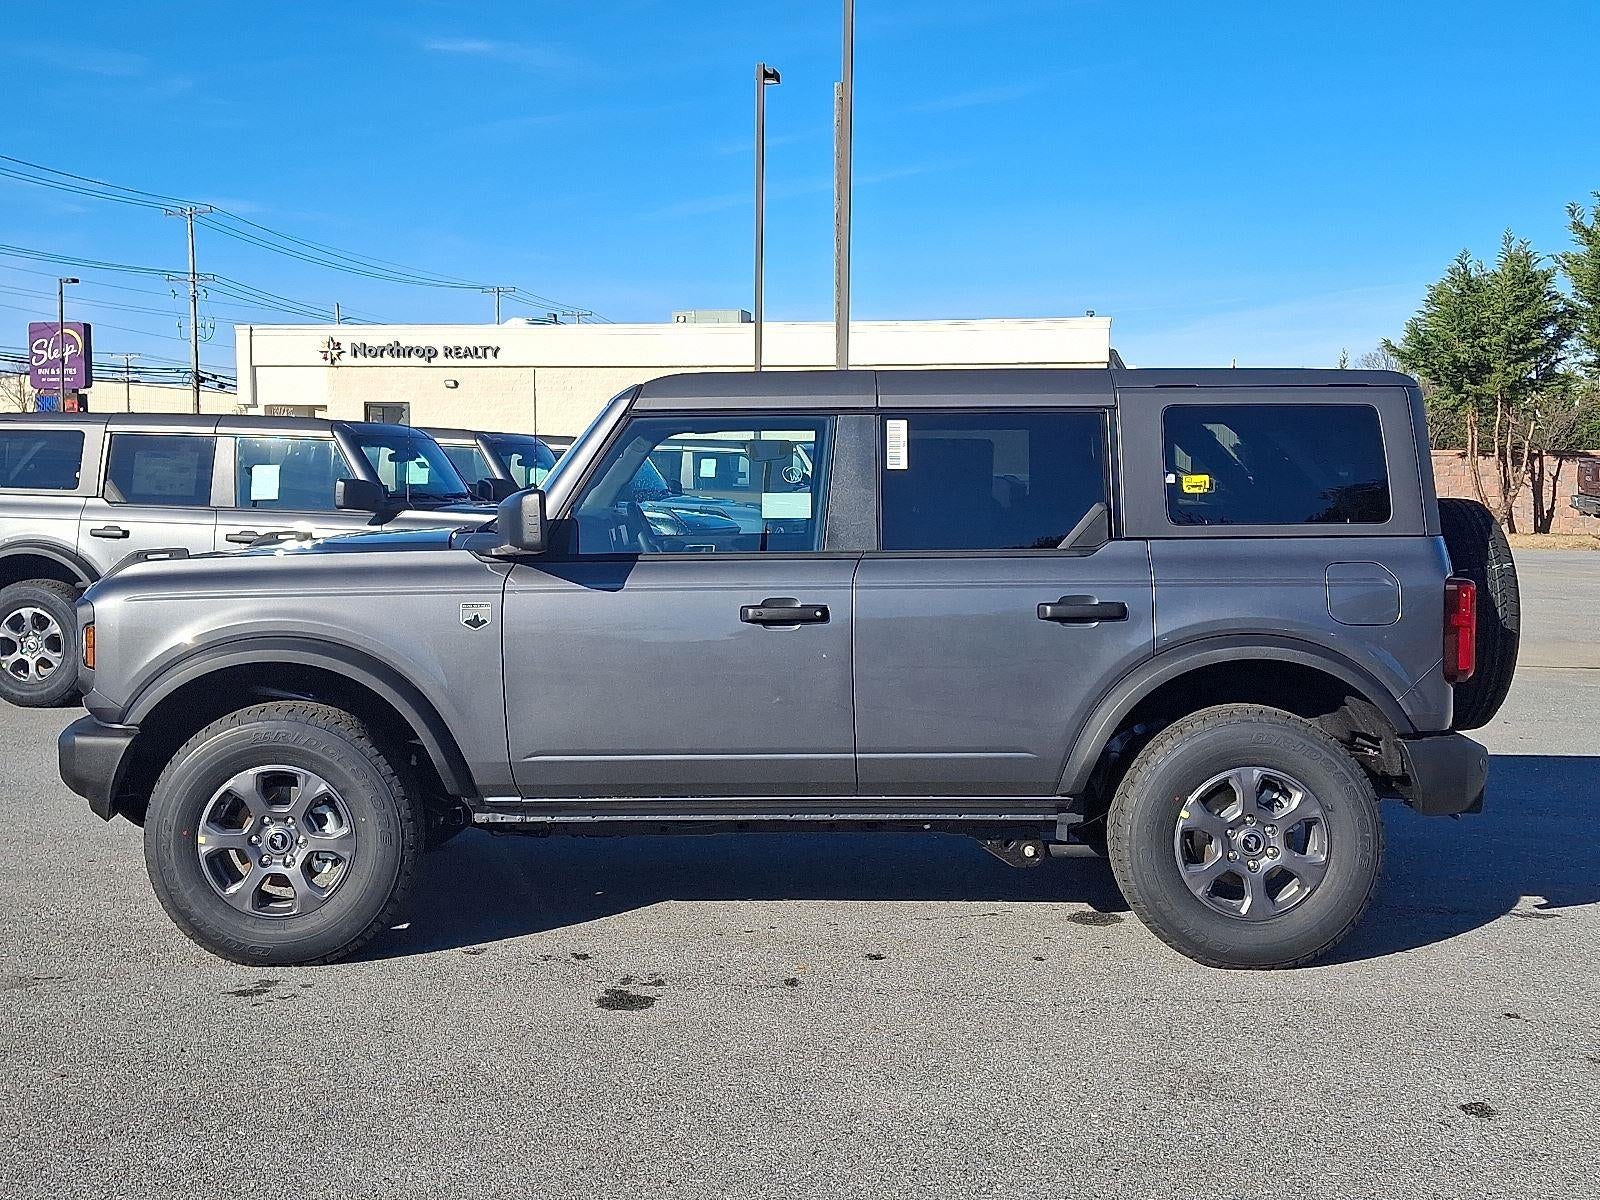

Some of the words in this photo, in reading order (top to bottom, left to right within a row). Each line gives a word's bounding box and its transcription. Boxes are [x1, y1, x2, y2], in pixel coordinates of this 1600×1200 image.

[32, 337, 77, 366] Slep
[351, 341, 438, 363] Northrop
[443, 346, 500, 359] REALTY
